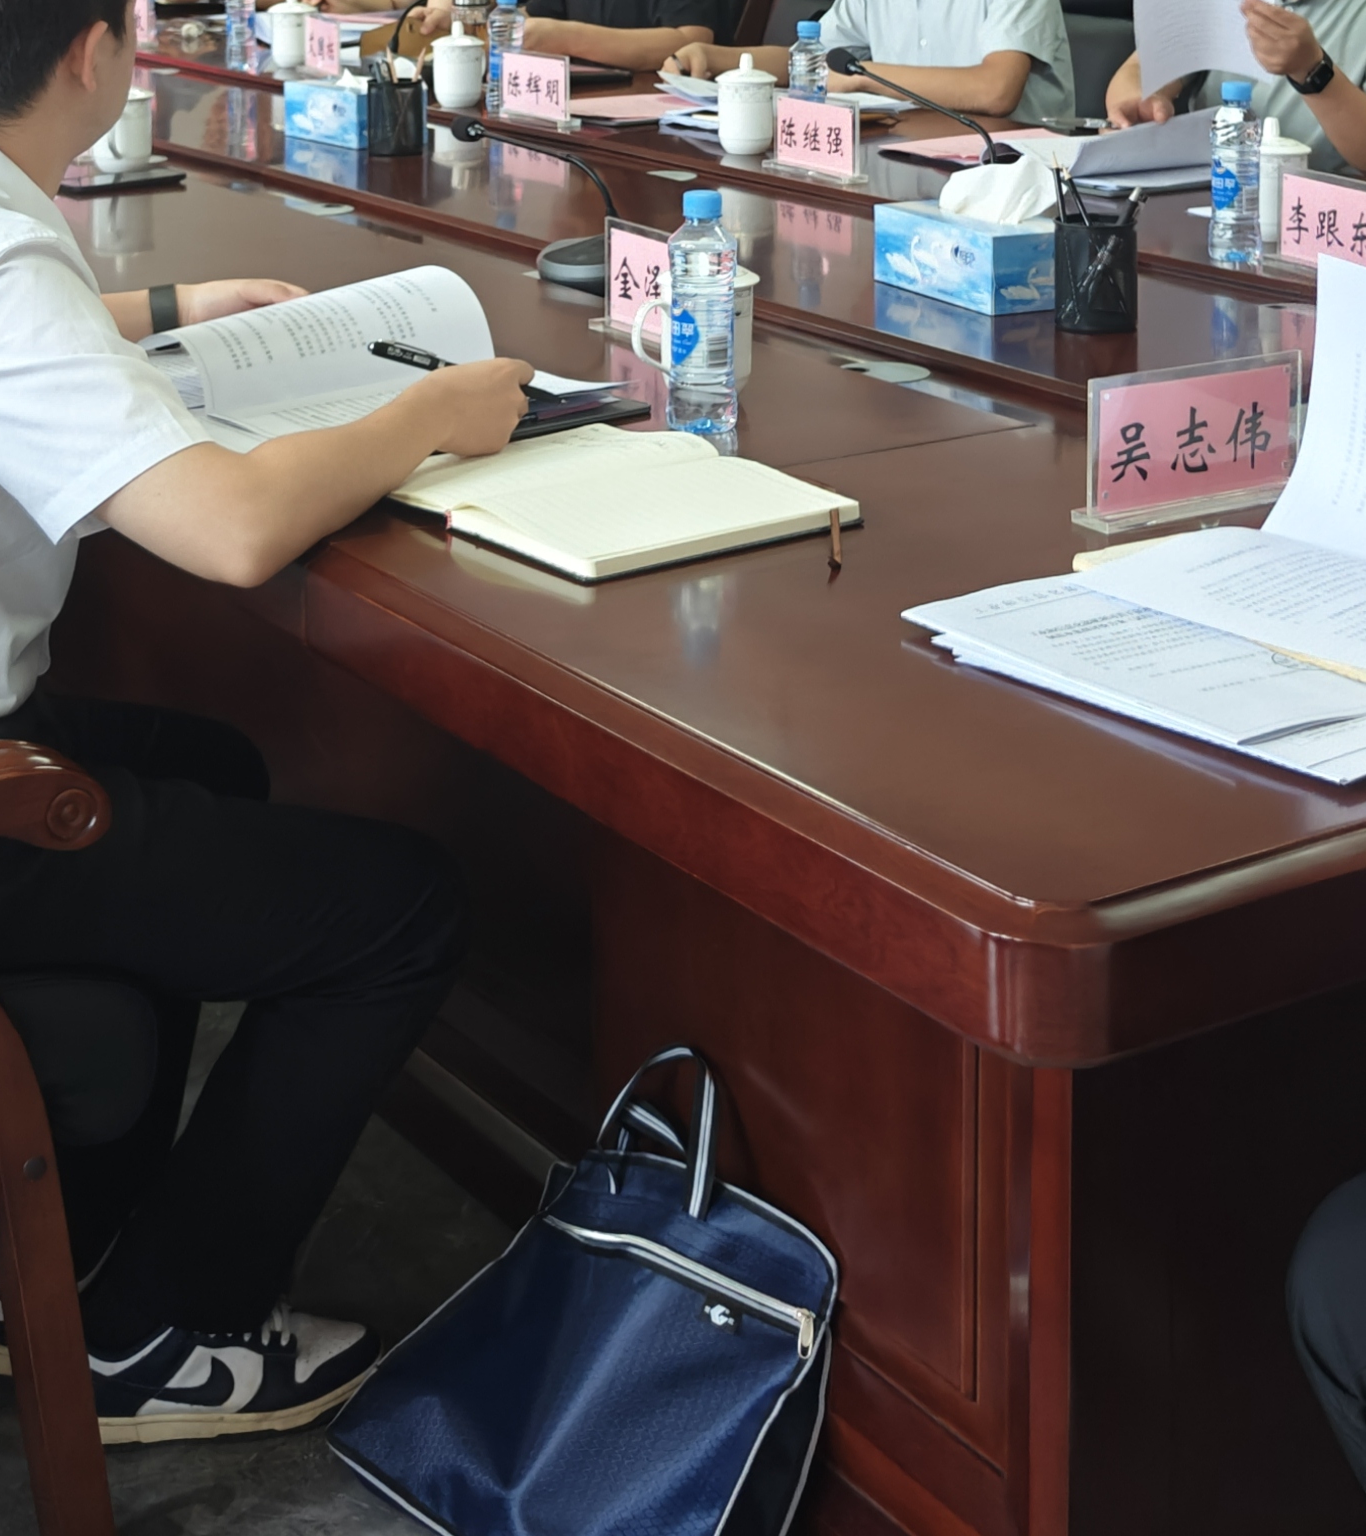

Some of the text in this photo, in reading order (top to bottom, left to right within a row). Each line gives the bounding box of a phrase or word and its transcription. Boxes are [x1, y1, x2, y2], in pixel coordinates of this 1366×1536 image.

[507, 69, 560, 107] 陈辉明
[780, 116, 844, 158] 陈继强
[1110, 401, 1272, 483] 吴志伟
